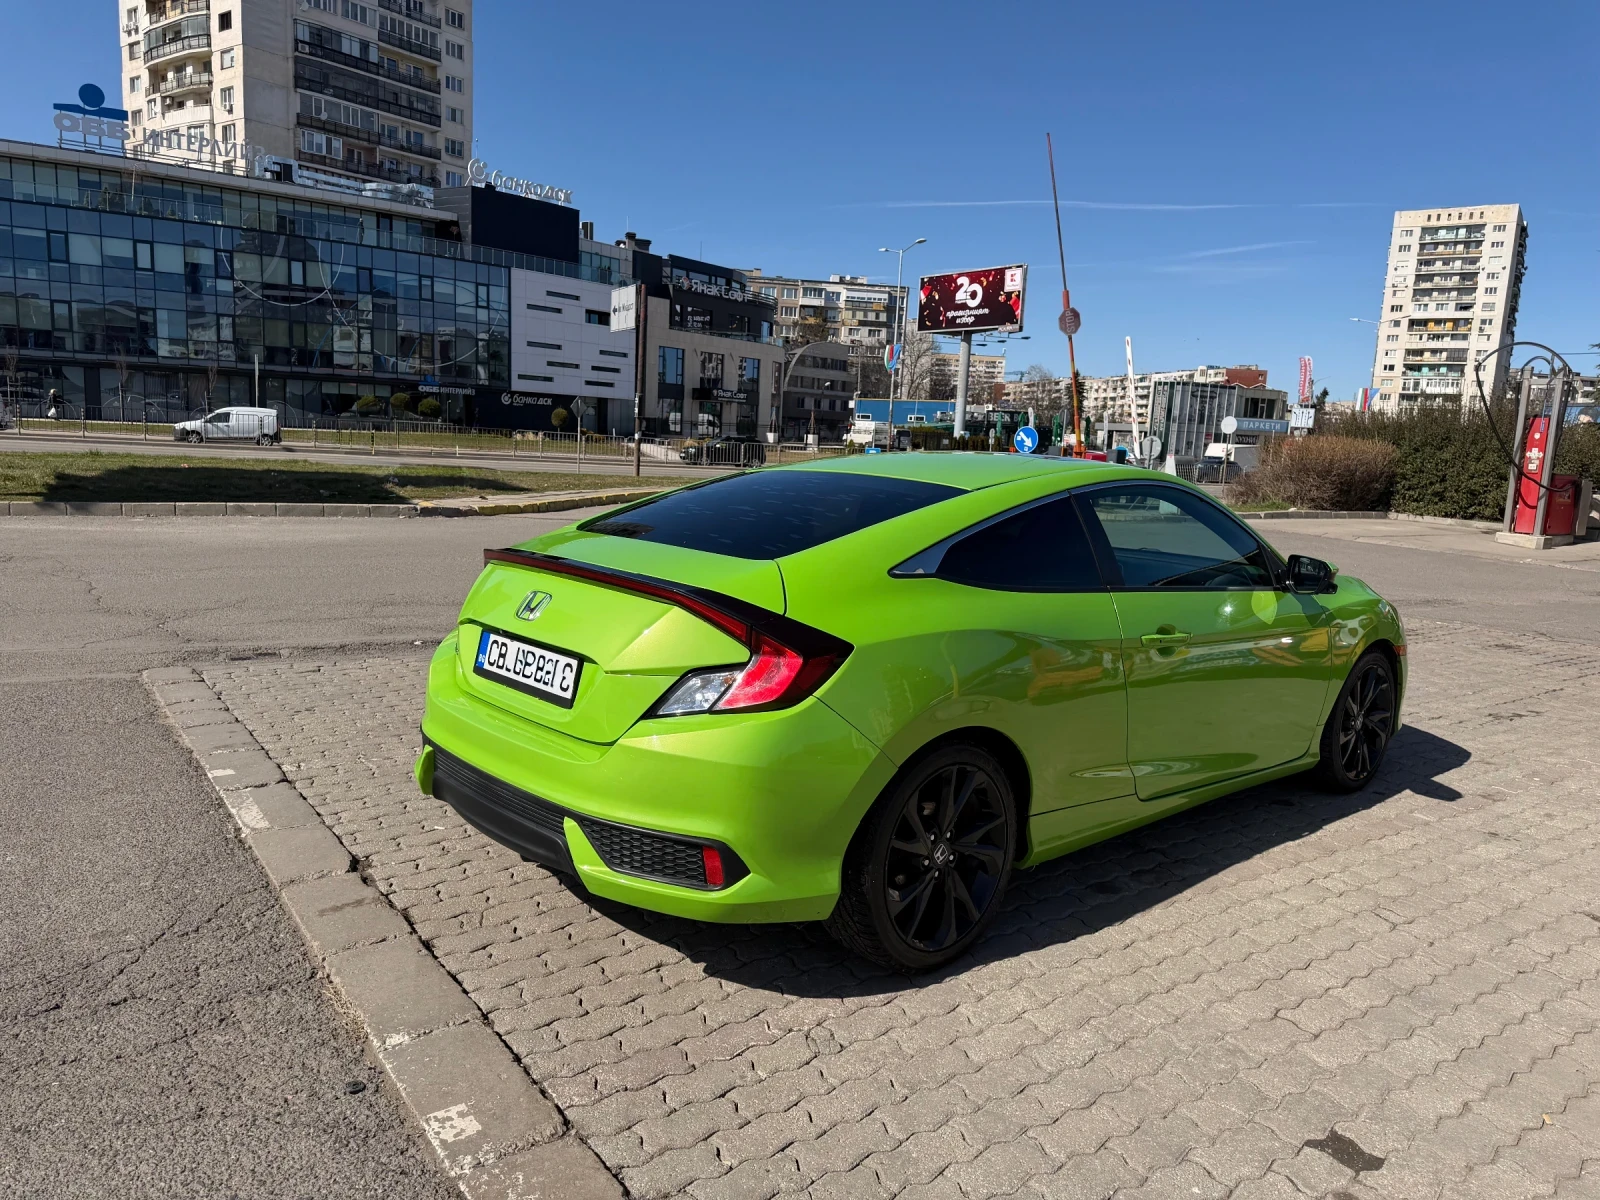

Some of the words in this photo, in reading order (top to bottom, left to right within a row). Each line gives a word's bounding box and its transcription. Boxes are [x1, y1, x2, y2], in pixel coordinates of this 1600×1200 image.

[53, 113, 131, 141] ОББ
[955, 276, 983, 308] 20
[1065, 310, 1076, 333] STOP
[418, 385, 439, 393] ОББ
[440, 386, 476, 396] ИНТЕРЛИЙЗ
[512, 393, 537, 404] банка
[1243, 421, 1281, 430] ПАРКЕТИ
